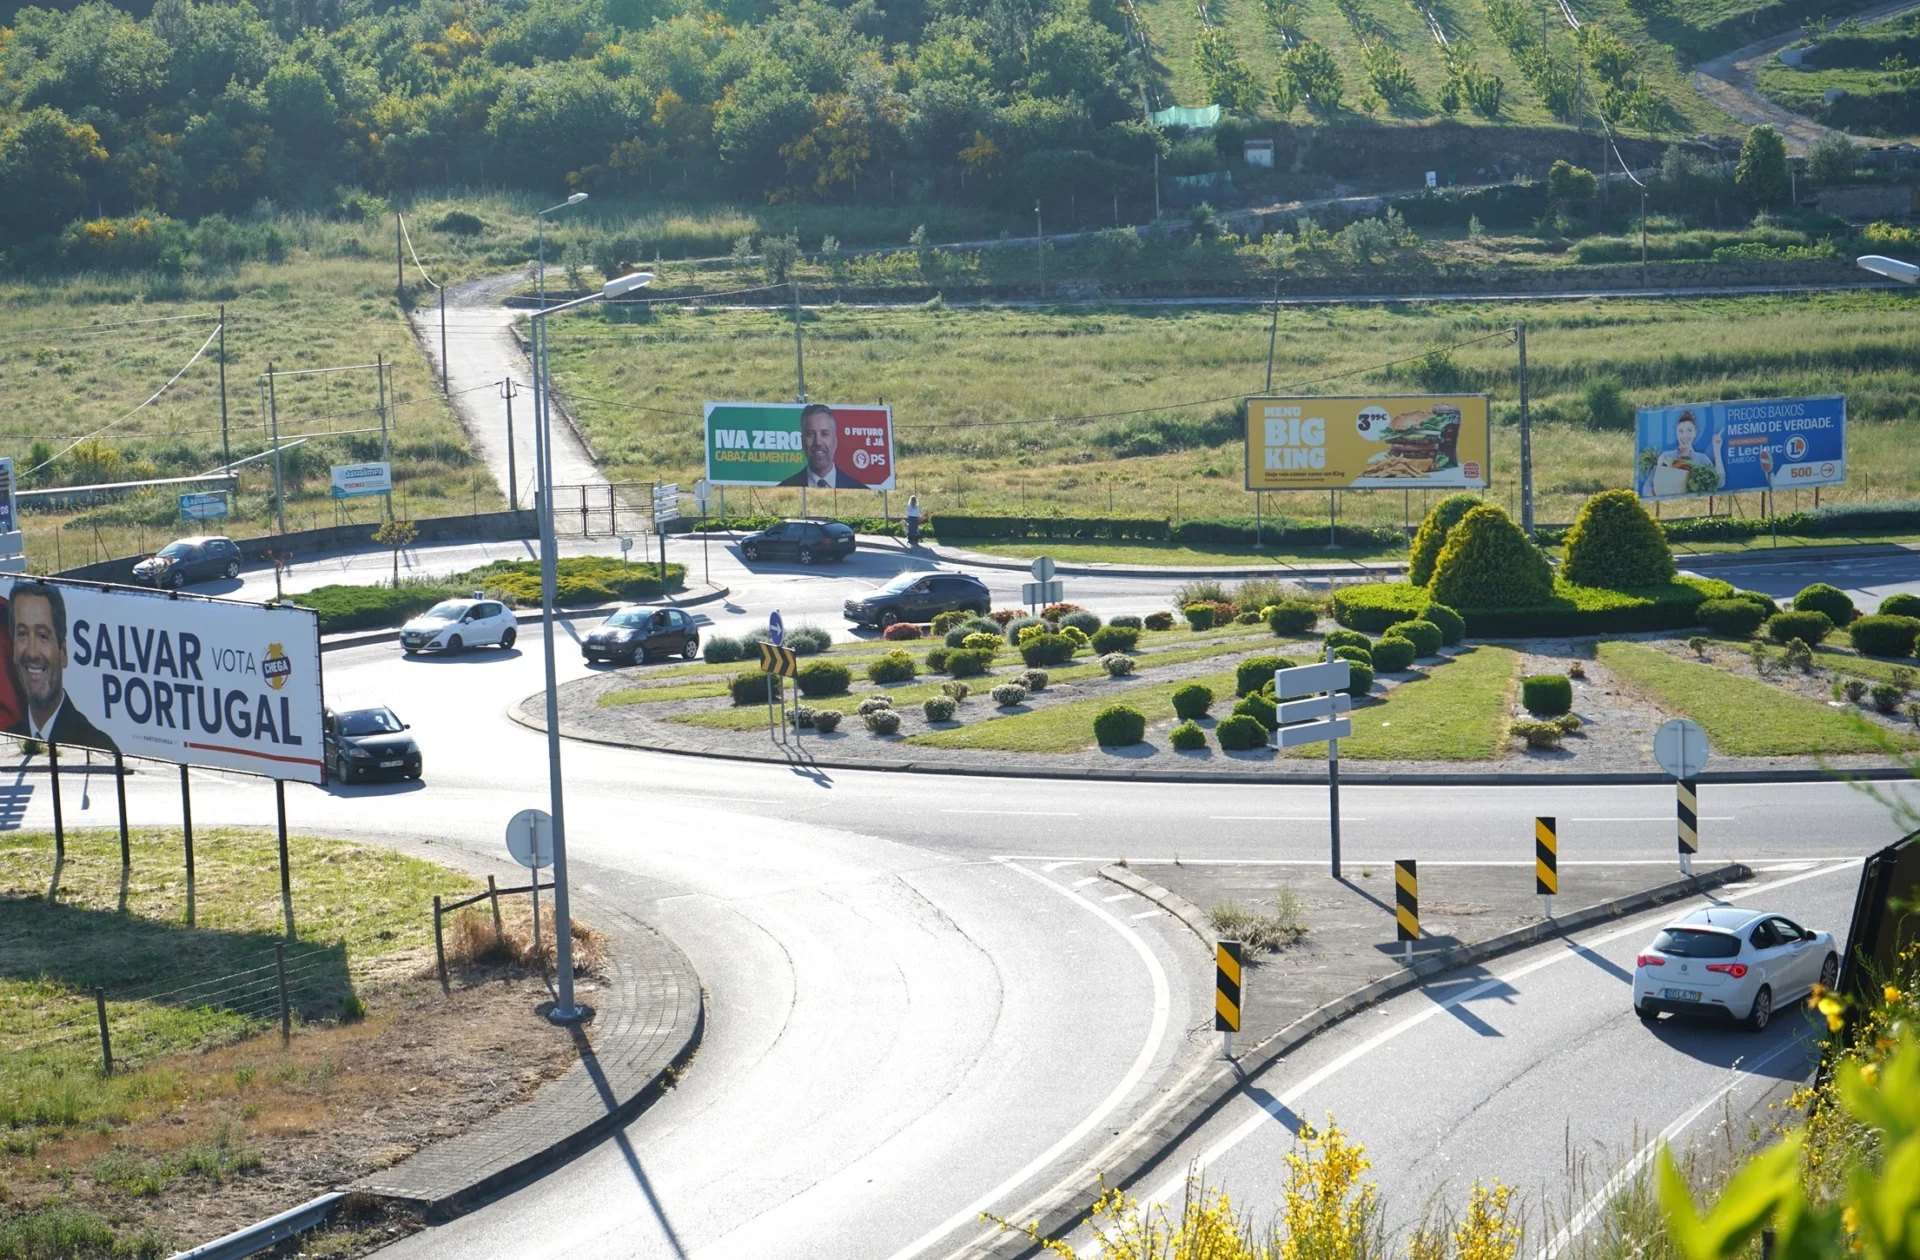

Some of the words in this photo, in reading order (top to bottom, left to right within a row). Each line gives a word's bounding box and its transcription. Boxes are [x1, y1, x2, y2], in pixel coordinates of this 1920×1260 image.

[1264, 406, 1301, 417] MENU
[1727, 407, 1767, 422] PREÇOS
[1768, 404, 1805, 418] BAIXOS
[844, 427, 851, 436] O
[852, 427, 884, 437] FUTURO
[1264, 417, 1326, 447] BIG
[1727, 421, 1766, 436] MESMO
[1768, 420, 1783, 433] DE
[1783, 416, 1834, 431] VERDADE.
[715, 429, 749, 449] IVA
[752, 430, 803, 451] ZERO
[865, 436, 872, 446] É
[872, 437, 885, 447] JÁ
[715, 450, 747, 463] CABAZ
[747, 451, 804, 464] ALIMENTAR
[870, 454, 886, 466] PS
[1264, 447, 1326, 470] KING
[1728, 456, 1756, 464] LAMEGO
[1790, 466, 1812, 478] 500
[72, 619, 203, 681] SALVAR
[211, 647, 257, 675] VOTA
[263, 659, 290, 676] CHEGA
[102, 673, 303, 746] PORTUGAL
